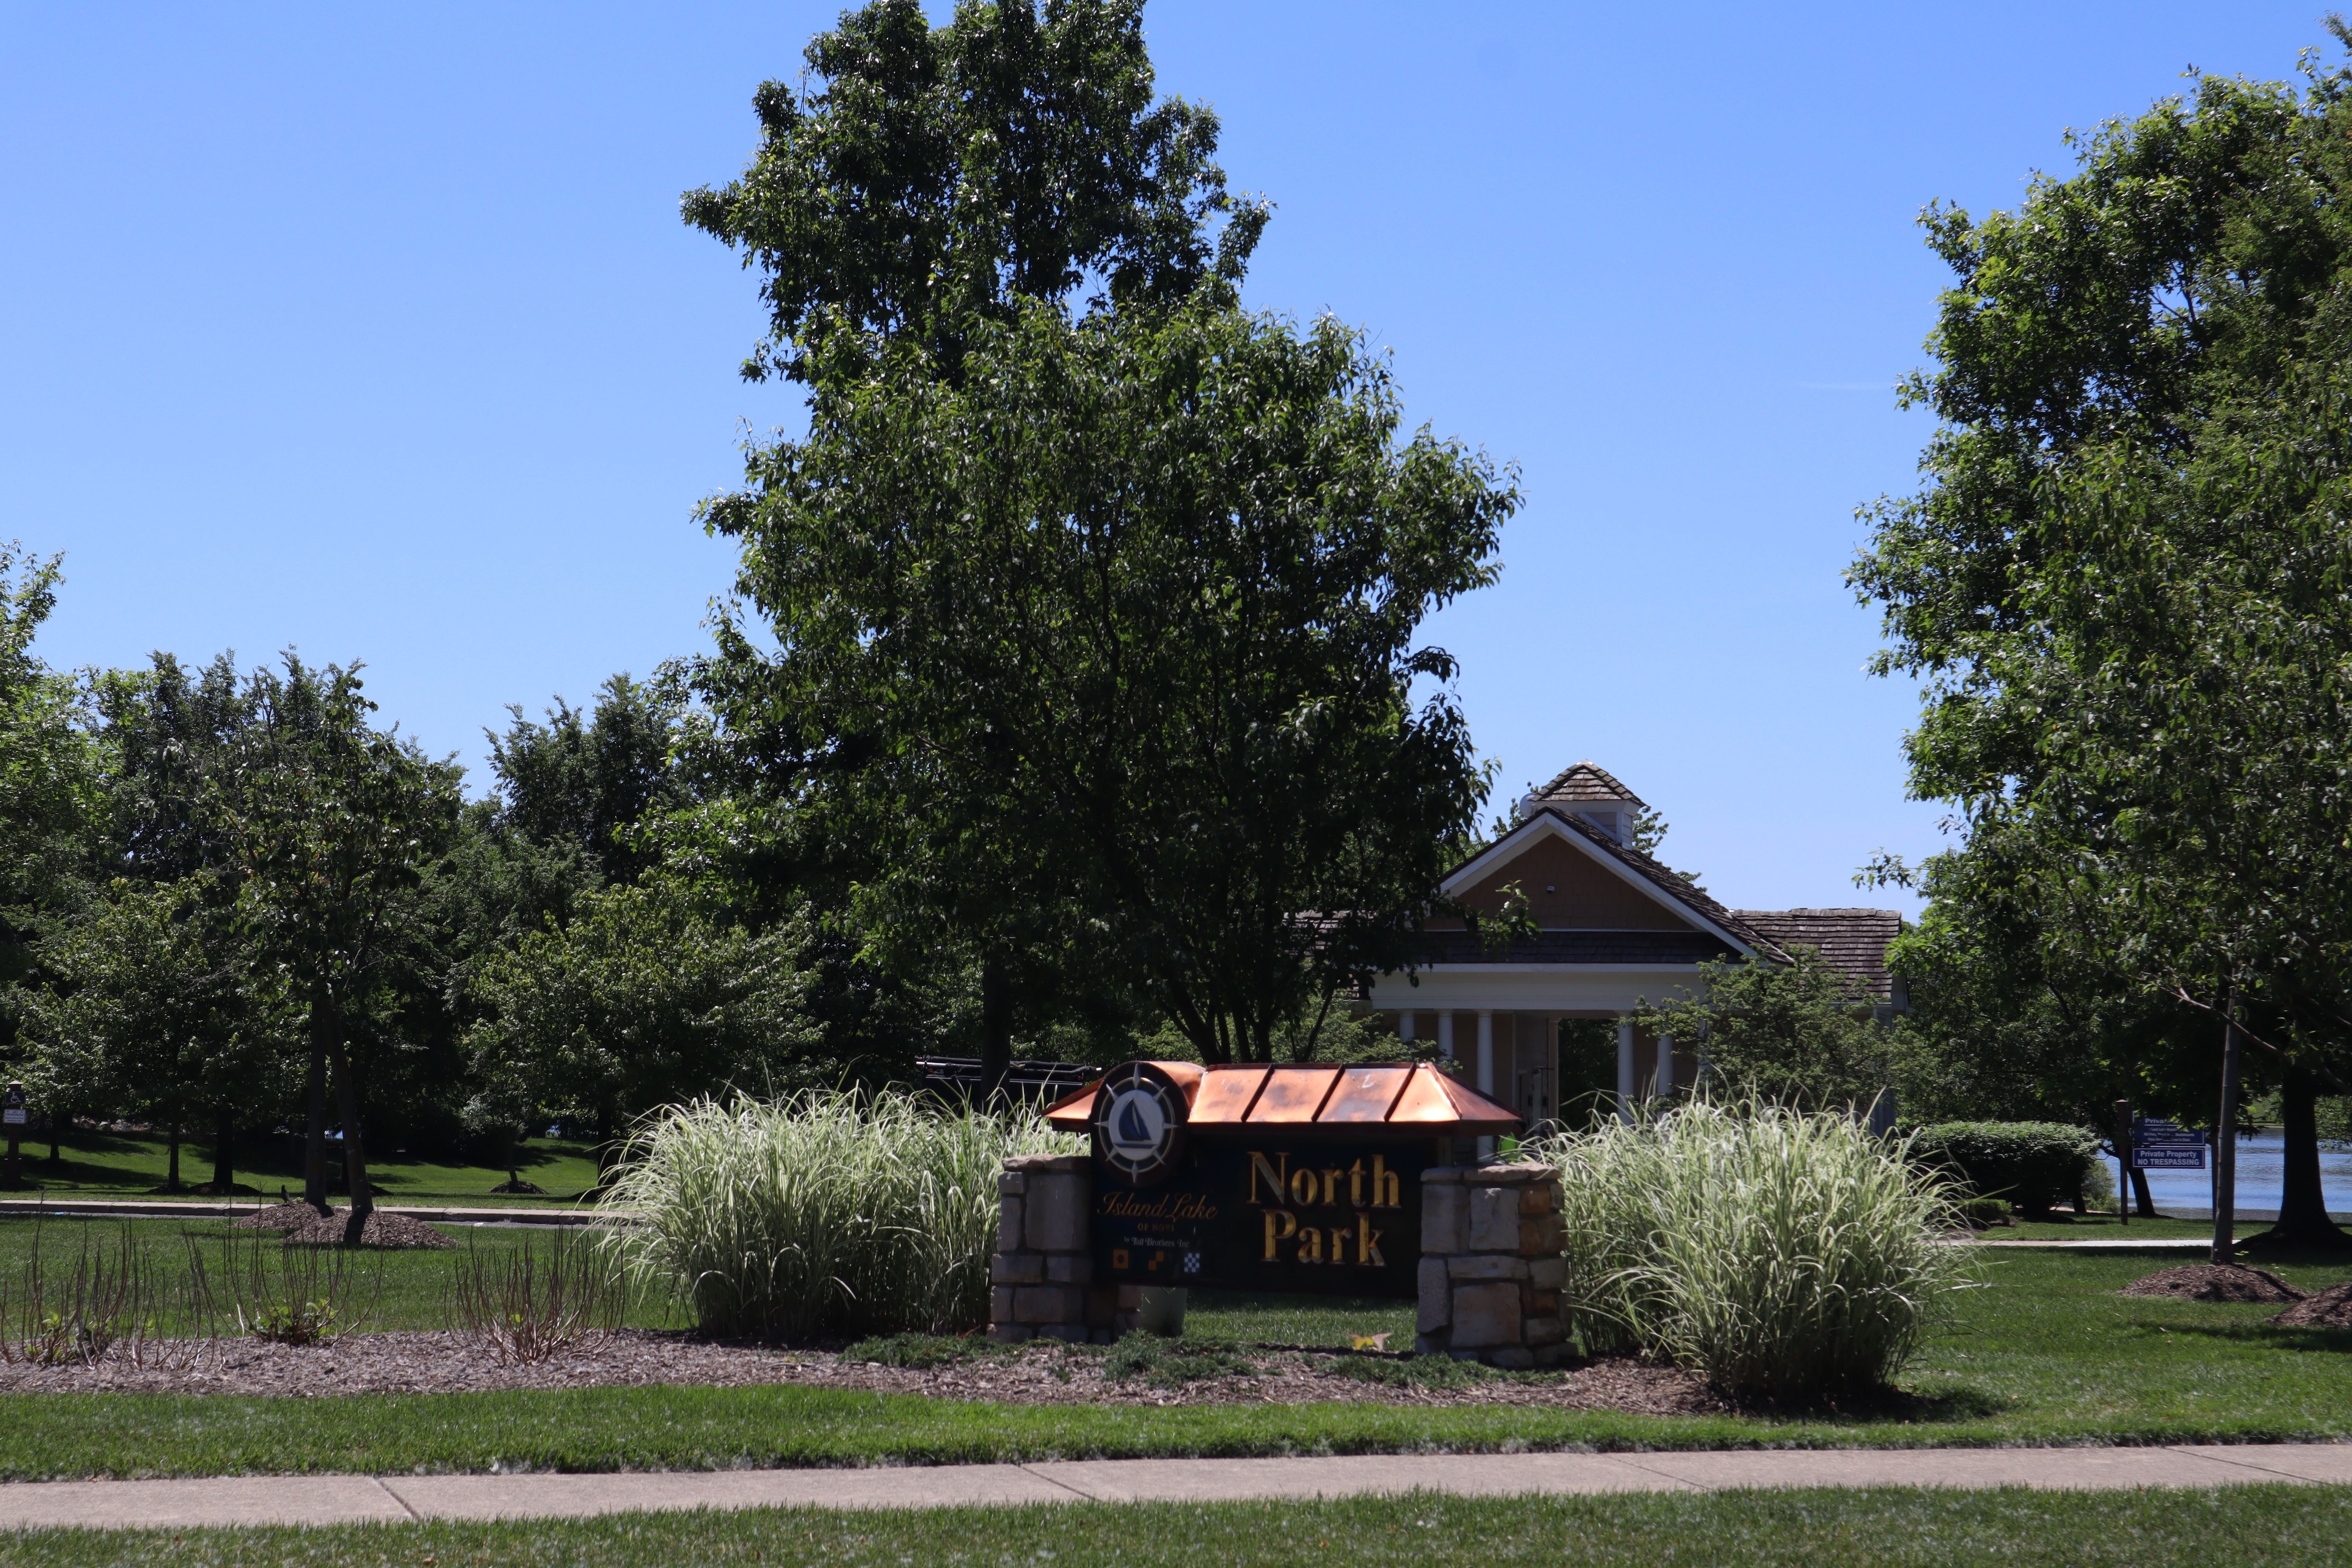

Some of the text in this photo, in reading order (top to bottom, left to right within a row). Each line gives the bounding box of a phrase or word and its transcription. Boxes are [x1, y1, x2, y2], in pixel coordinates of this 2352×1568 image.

[2167, 1151, 2197, 1159] Property
[1245, 1151, 1402, 1208] North
[1097, 1191, 1219, 1223] Island Lake
[1137, 1223, 1174, 1232] OF NOVI
[1260, 1208, 1387, 1267] Park
[1131, 1237, 1144, 1245] Toll
